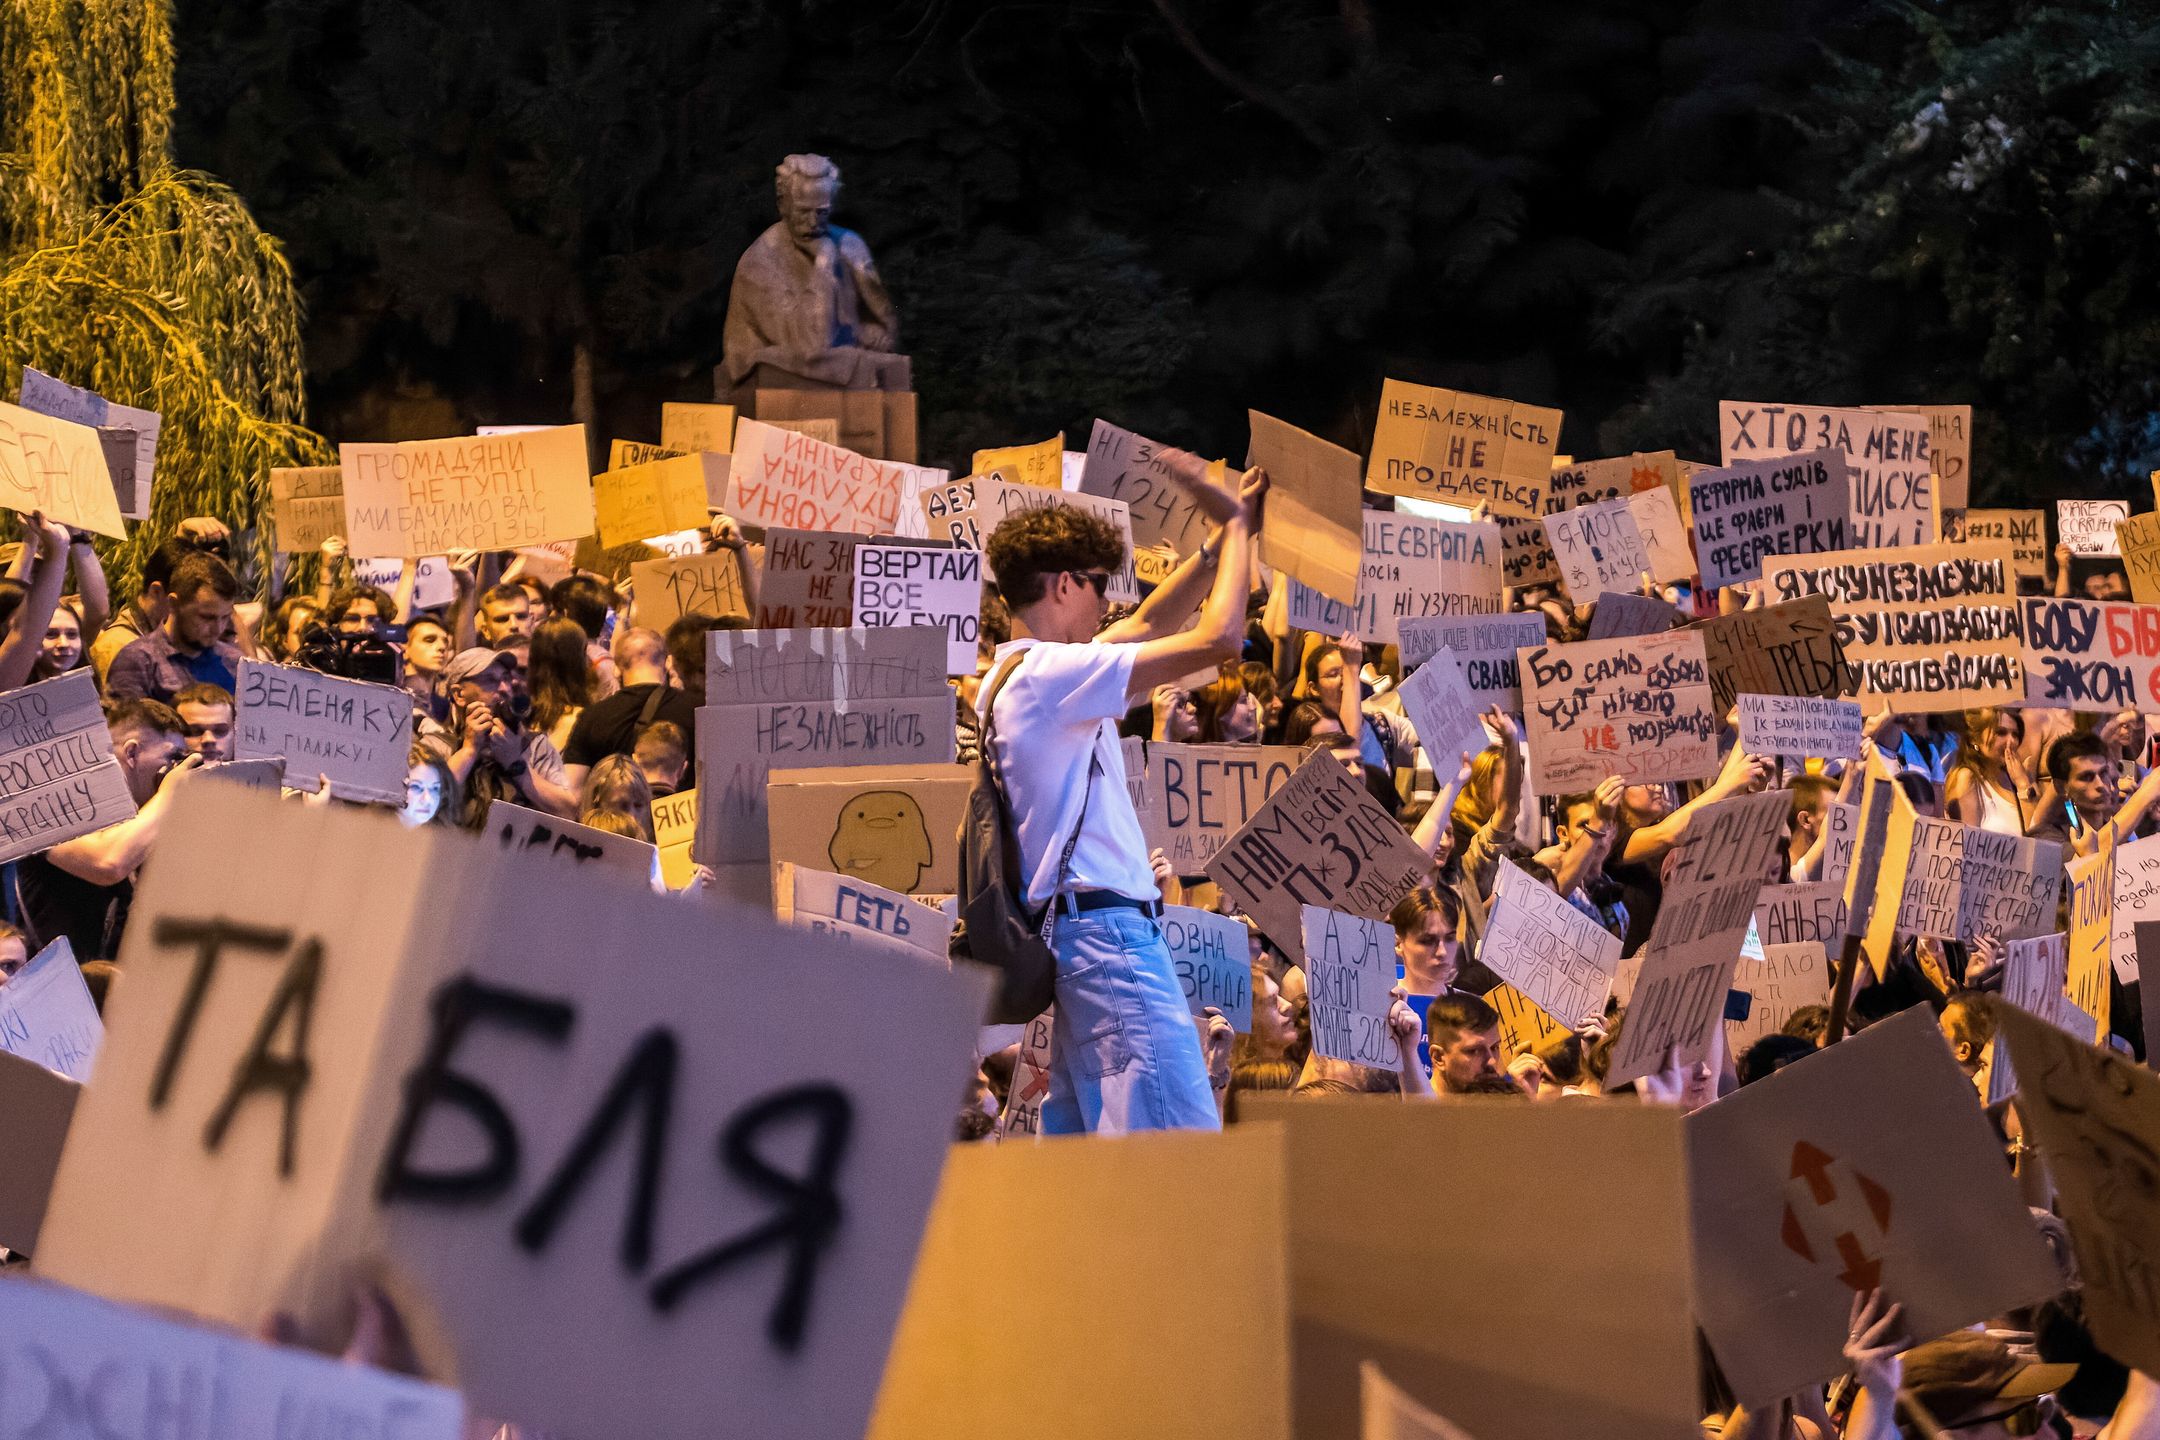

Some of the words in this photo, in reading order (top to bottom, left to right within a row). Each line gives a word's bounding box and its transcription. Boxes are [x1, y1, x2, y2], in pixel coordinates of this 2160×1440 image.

[1095, 428, 1121, 460] НІ
[1447, 435, 1487, 468] НЕ
[1729, 407, 1808, 450] ХТО
[1815, 414, 1854, 455] ЗА
[1863, 424, 1930, 463] МЕНЕ
[356, 440, 526, 480] ГРОМАДЯНИ
[783, 432, 903, 496] УКРАЇНИ
[408, 475, 446, 506] НЕ
[763, 452, 896, 525] ПУХЛИНА
[1387, 458, 1540, 514] ПРОДАЄТЬСЯ
[1691, 473, 1765, 515] РЕФОРМА
[1770, 460, 1829, 494] СУДІВ
[2060, 501, 2098, 517] MAKE
[353, 506, 390, 533] МИ
[397, 498, 494, 533] БАЧИМО
[503, 489, 547, 518] ВАС
[1699, 517, 1725, 543] ЦЕ
[411, 517, 548, 555] НАСКРІЗЬ!
[770, 537, 815, 571] НАС
[1365, 523, 1395, 559] ЦЕ
[1710, 517, 1845, 578] ФЕЄРВЕРКИ
[2074, 541, 2104, 553] AGAIN
[809, 574, 834, 601] НЕ
[859, 549, 980, 582] ВЕРТАЙ
[859, 580, 924, 611] ВСЕ
[1392, 586, 1413, 617] НІ
[1422, 591, 1502, 617] УЗУРПАЦІЇ
[1443, 627, 1468, 651] ДЕ
[1766, 632, 1852, 697] ТРЕБА
[2041, 655, 2138, 708] ЗАКОН
[243, 671, 409, 743] ЗЕЛЕНЯКУ
[756, 705, 926, 754] НЕЗАЛЕЖНІСТЬ
[244, 725, 267, 745] НА
[1582, 723, 1620, 750] НЕ
[1164, 757, 1292, 829] ВЕТО
[1301, 775, 1358, 834] ВСІМ
[1832, 806, 1848, 832] В
[1173, 833, 1194, 860] НА
[1220, 804, 1313, 904] НАМ
[1928, 853, 2055, 902] ПОВЕРТАЮТЬСЯ
[835, 884, 911, 936] ГЕТЬ
[1518, 878, 1607, 966] 12414
[1756, 897, 1848, 946] АНЬБА
[1973, 892, 1991, 919] НЕ
[1995, 900, 2045, 927] СТАРІ
[1162, 920, 1226, 961] ОВНА
[1324, 909, 1342, 964] А
[1352, 916, 1382, 972] ЗА
[1515, 918, 1606, 991] НОМЕР
[1175, 960, 1247, 1010] ЗРАДА
[1311, 960, 1360, 1011] ВІКНОМ
[150, 913, 326, 1181] ТА
[385, 973, 854, 1354] БЛЯ
